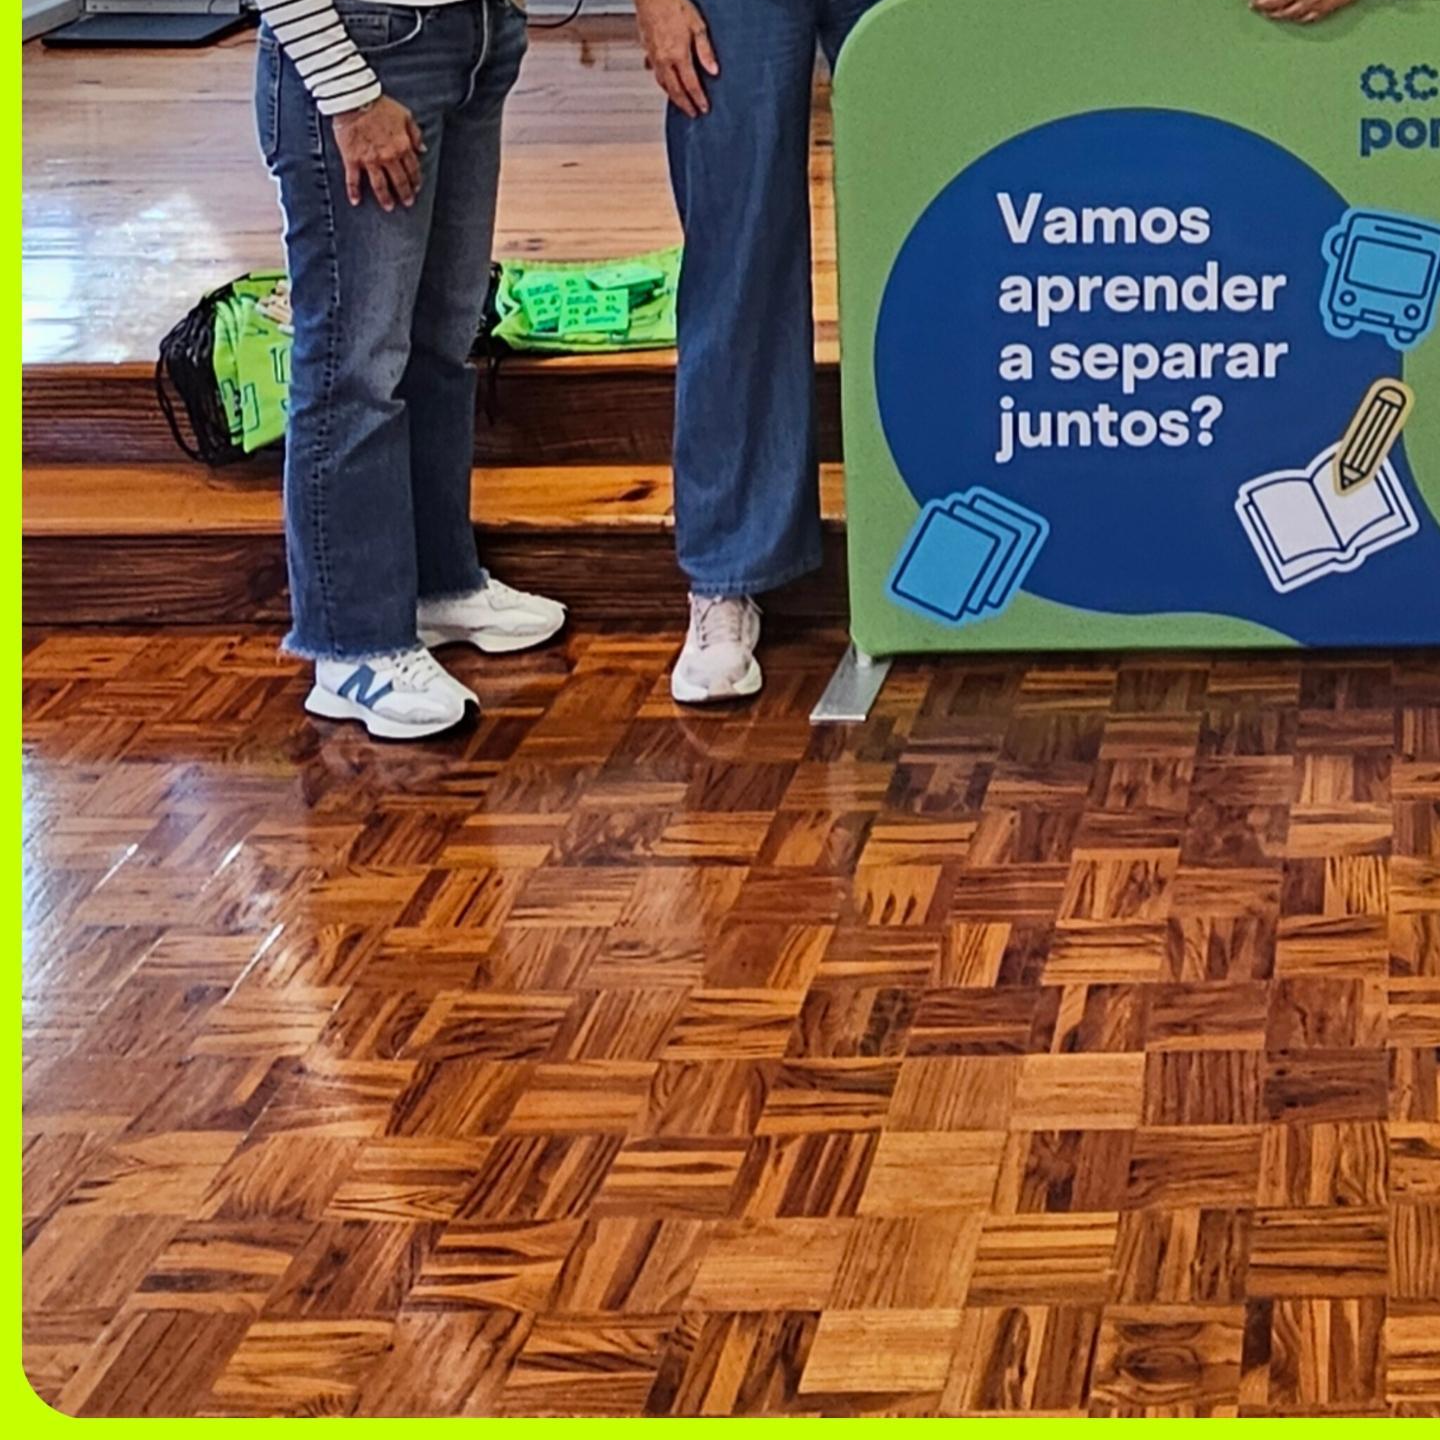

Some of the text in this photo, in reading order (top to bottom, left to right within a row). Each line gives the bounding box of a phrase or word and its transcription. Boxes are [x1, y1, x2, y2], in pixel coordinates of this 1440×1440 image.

[996, 192, 1210, 244] Vamos
[998, 261, 1287, 327] aprender
[998, 342, 1289, 394] a separar
[995, 395, 1224, 464] juntos?
